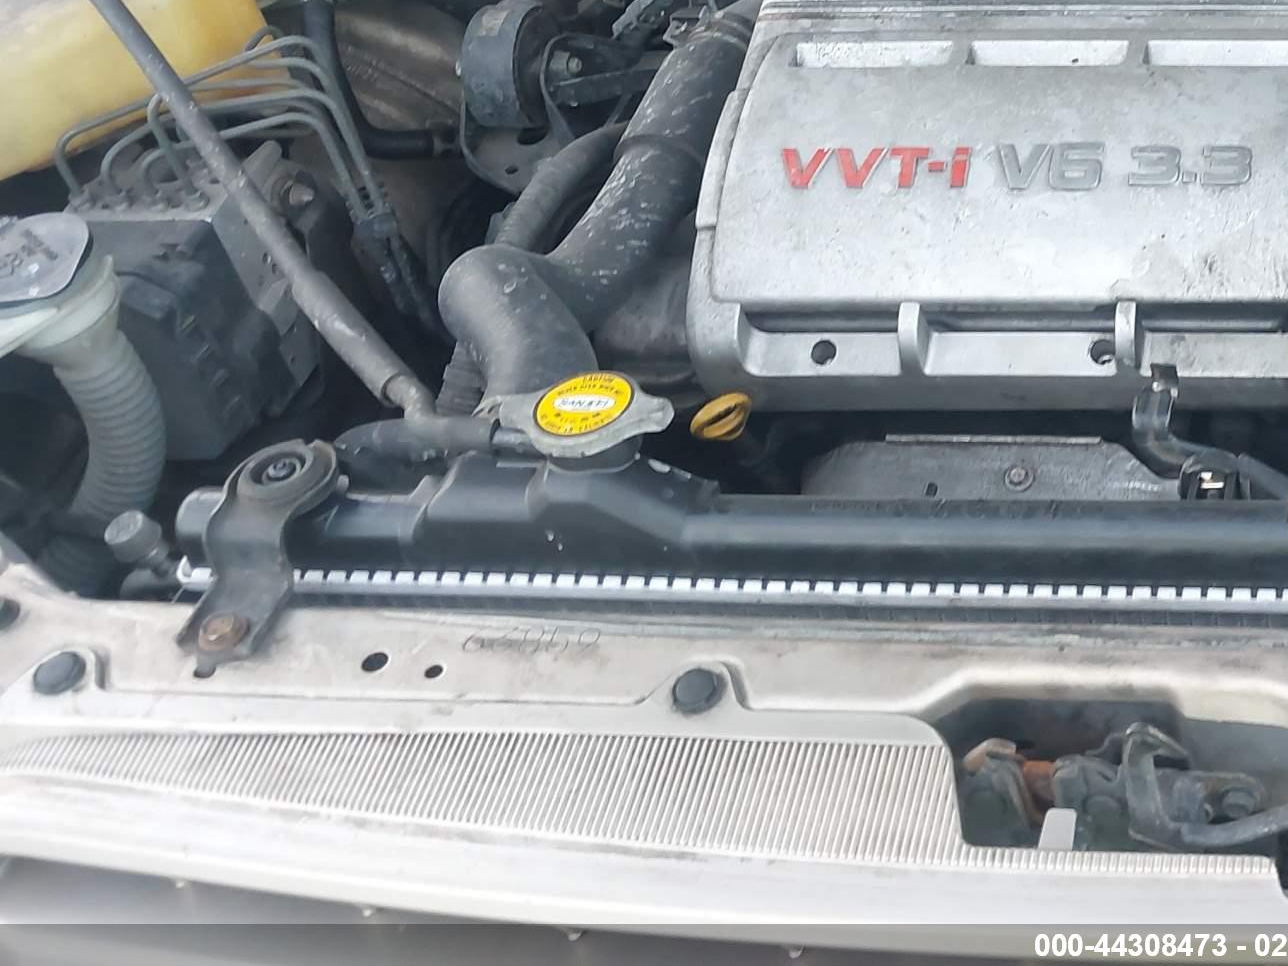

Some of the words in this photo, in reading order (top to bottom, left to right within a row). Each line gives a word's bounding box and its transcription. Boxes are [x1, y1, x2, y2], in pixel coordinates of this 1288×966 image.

[782, 146, 973, 189] VVT-i
[999, 142, 1104, 191] V6
[1127, 143, 1253, 188] 3.3
